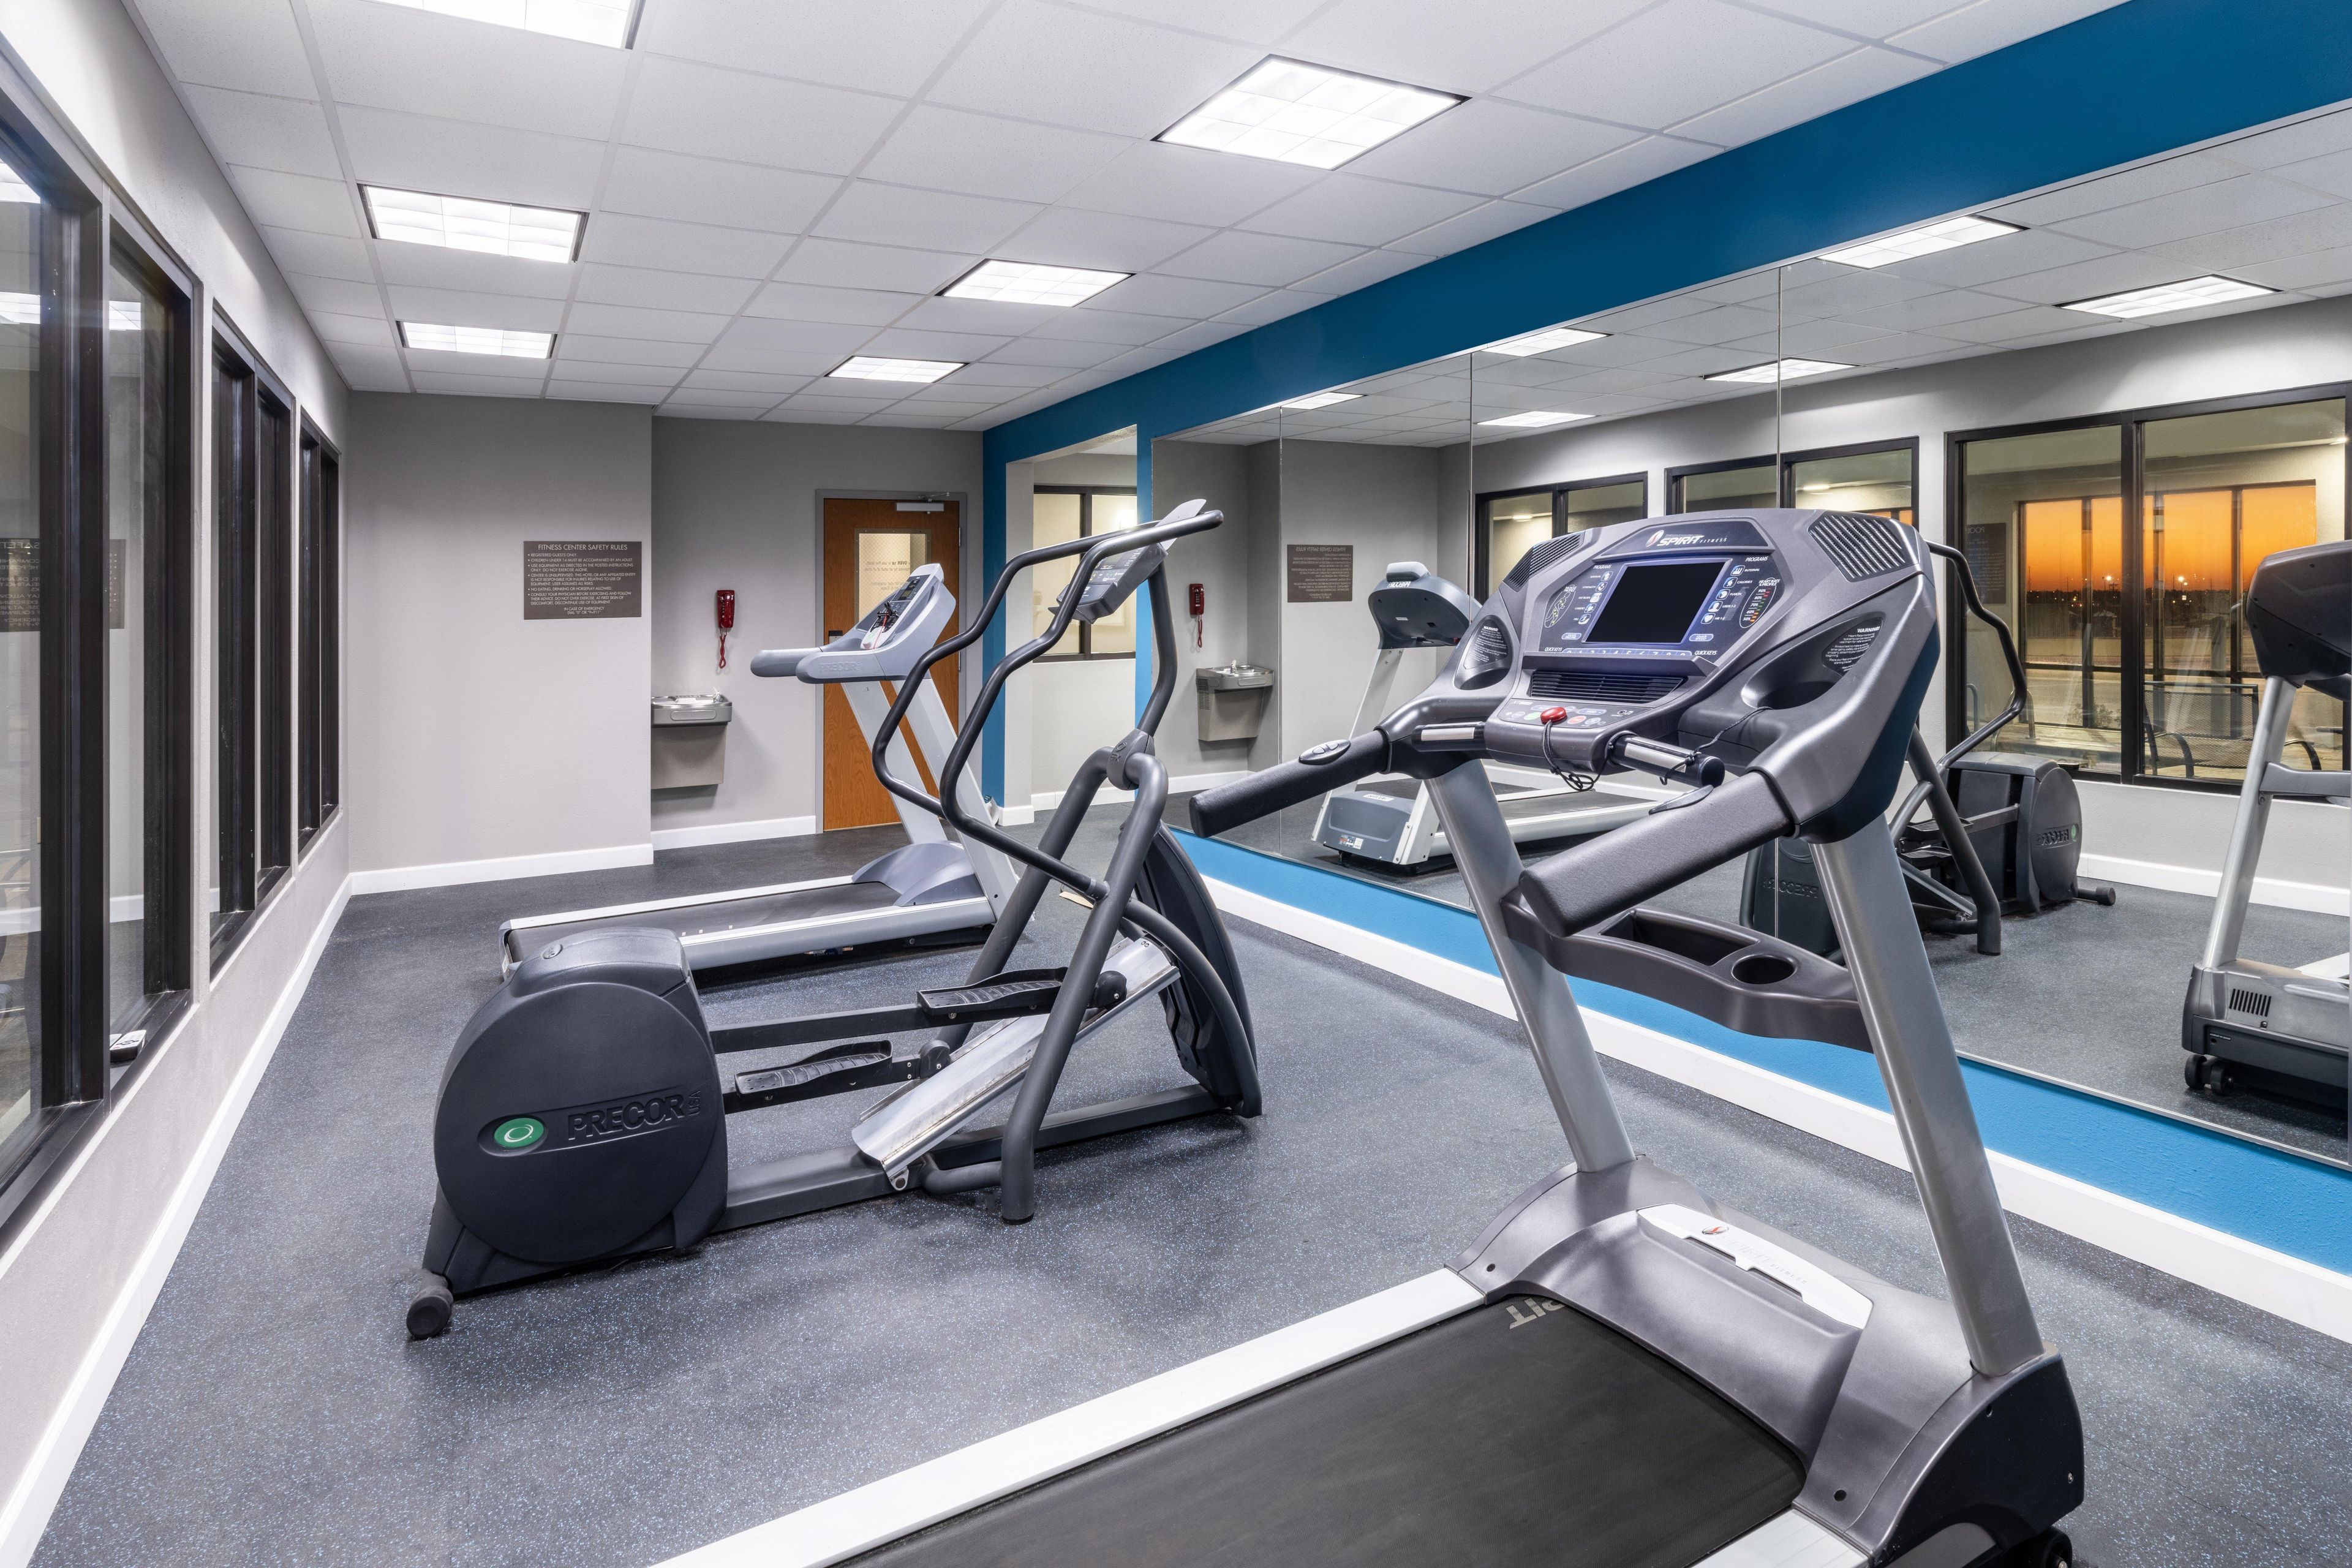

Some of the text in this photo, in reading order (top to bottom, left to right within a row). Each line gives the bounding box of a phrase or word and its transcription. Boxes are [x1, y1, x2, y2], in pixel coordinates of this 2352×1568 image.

[1657, 535, 1705, 546] SPIRIT
[568, 1094, 685, 1141] PRECOR
[1770, 1264, 1807, 1284] FITNESS
